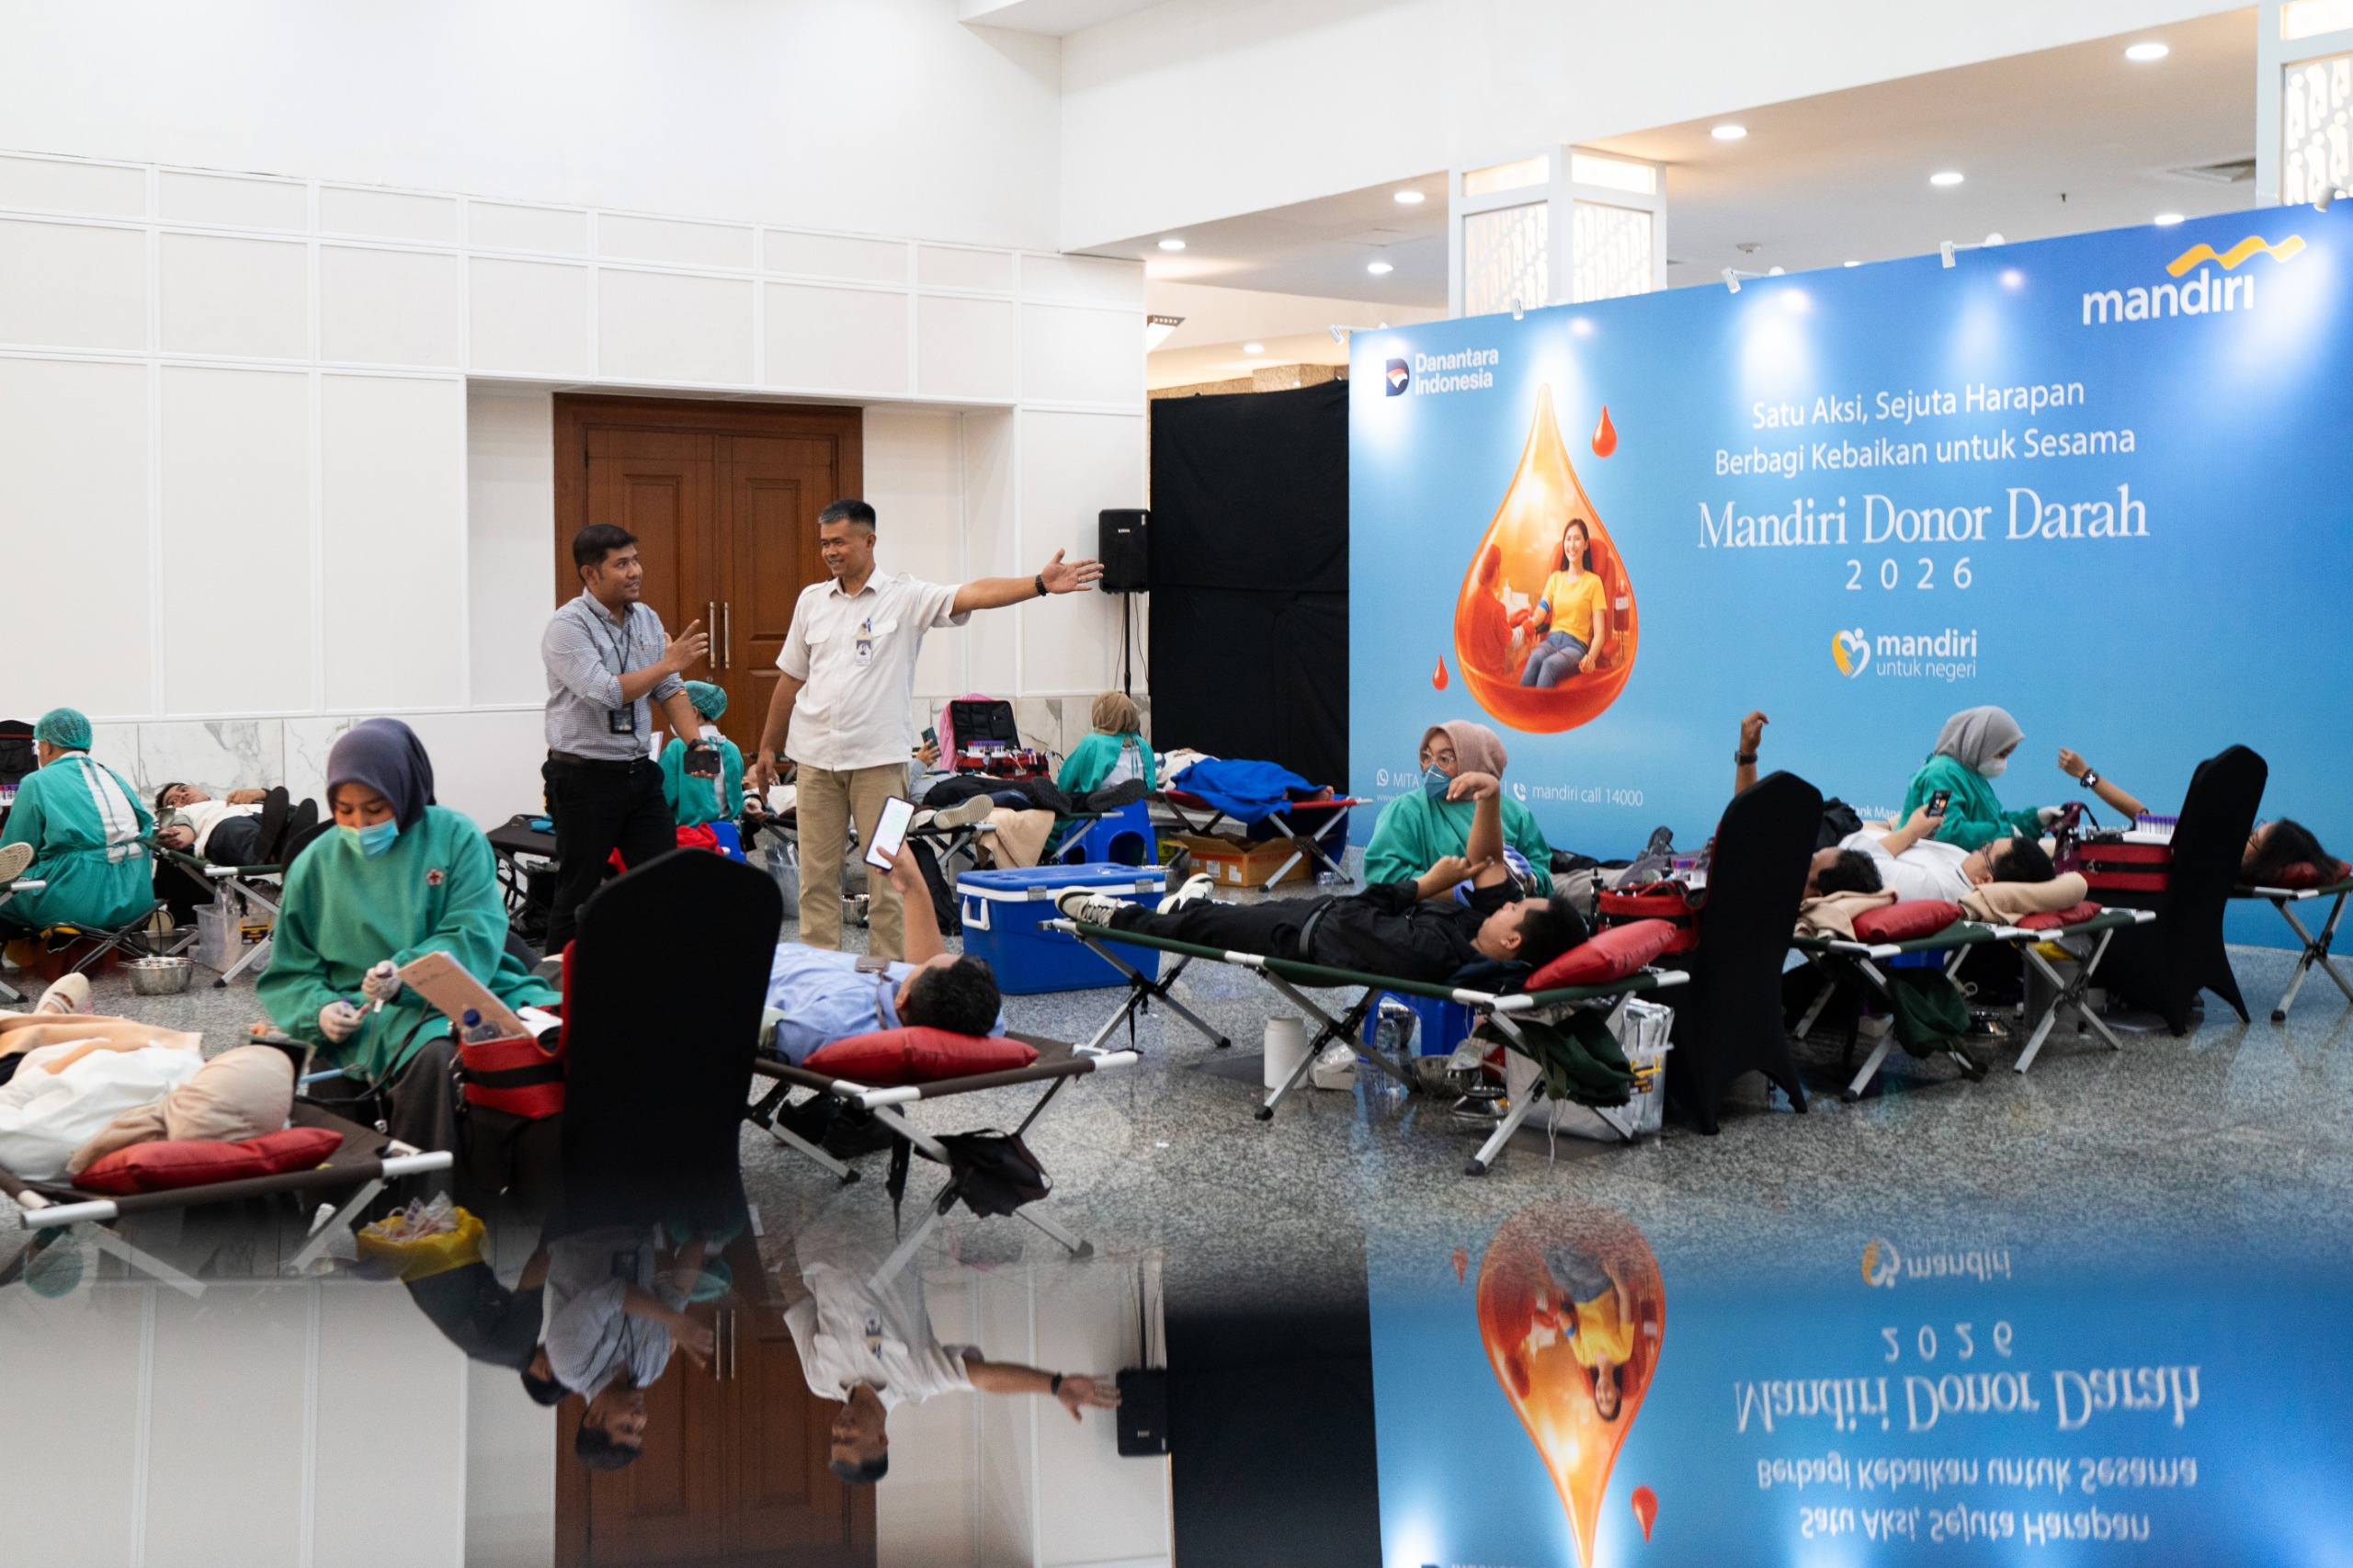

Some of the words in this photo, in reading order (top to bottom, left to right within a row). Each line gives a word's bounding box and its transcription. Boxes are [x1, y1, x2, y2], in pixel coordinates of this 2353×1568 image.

[2084, 268, 2254, 325] mandiri
[1416, 348, 1499, 372] Danantara
[1416, 369, 1493, 394] Indonesia
[1752, 399, 1805, 429] Satu
[1813, 393, 1869, 426] Aksi,
[1876, 386, 1958, 424] Sejuta
[1965, 380, 2085, 414] Harapan
[1715, 444, 1804, 477] Berbagi
[1812, 438, 1927, 470] Kebaikan
[1937, 431, 2016, 462] untuk
[2023, 427, 2136, 457] Sesama
[1699, 496, 1848, 549] Mandiri
[1863, 493, 1992, 544] Donor
[2006, 483, 2150, 540] Darah
[1876, 628, 1977, 657] mandiri
[1876, 658, 1922, 677] untuk
[1926, 659, 1976, 683] negeri
[1393, 772, 1420, 789] MITA
[1532, 785, 1578, 802] mandiri
[1581, 788, 1601, 804] call
[1606, 789, 1643, 808] 14000
